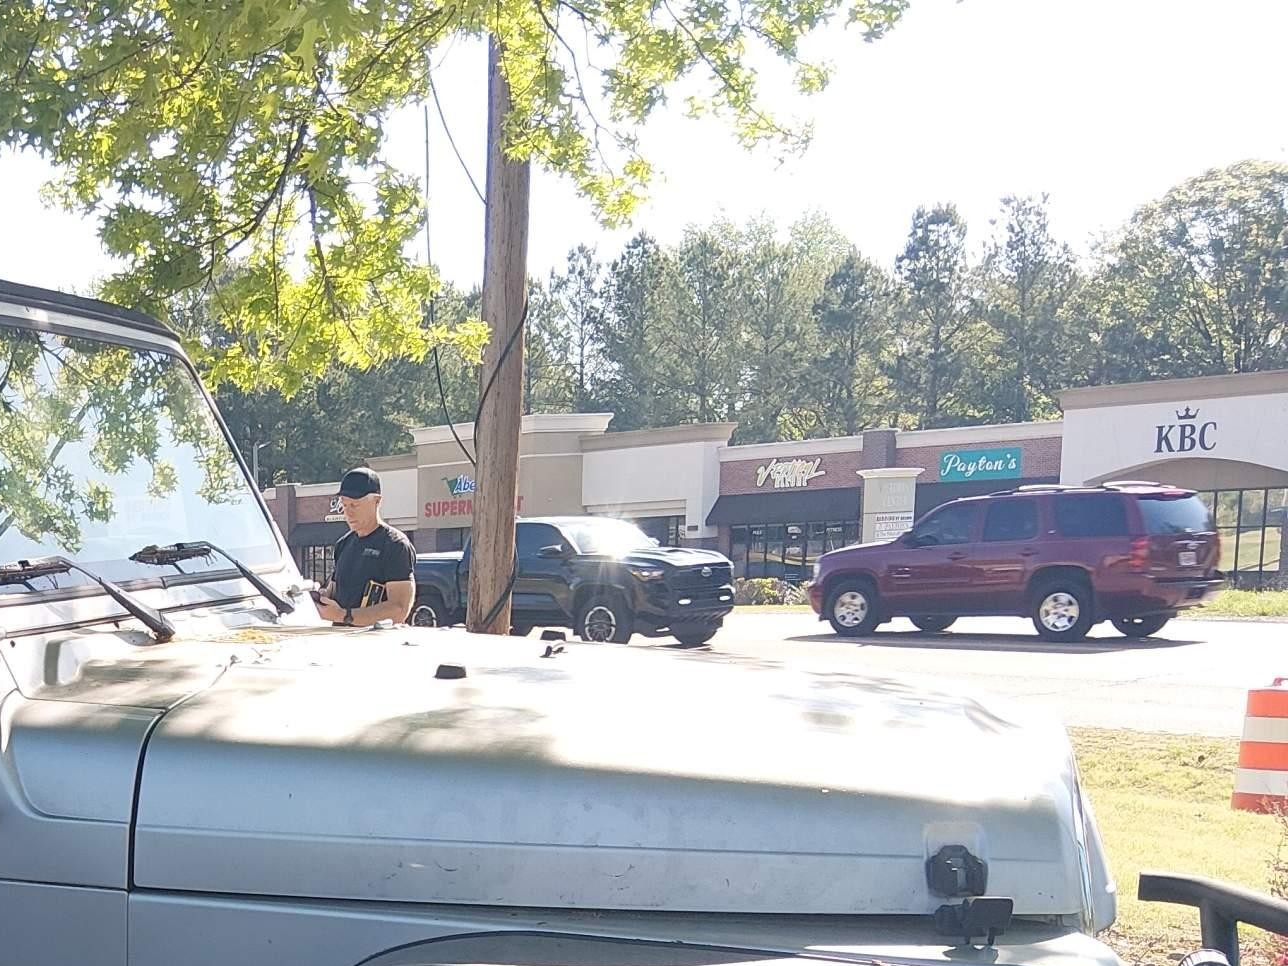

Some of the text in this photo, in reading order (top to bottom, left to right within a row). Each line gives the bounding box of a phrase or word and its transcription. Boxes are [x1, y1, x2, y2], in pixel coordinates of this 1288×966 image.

[1154, 421, 1218, 453] KBC
[940, 453, 1017, 477] Payton's
[453, 475, 477, 493] Abe
